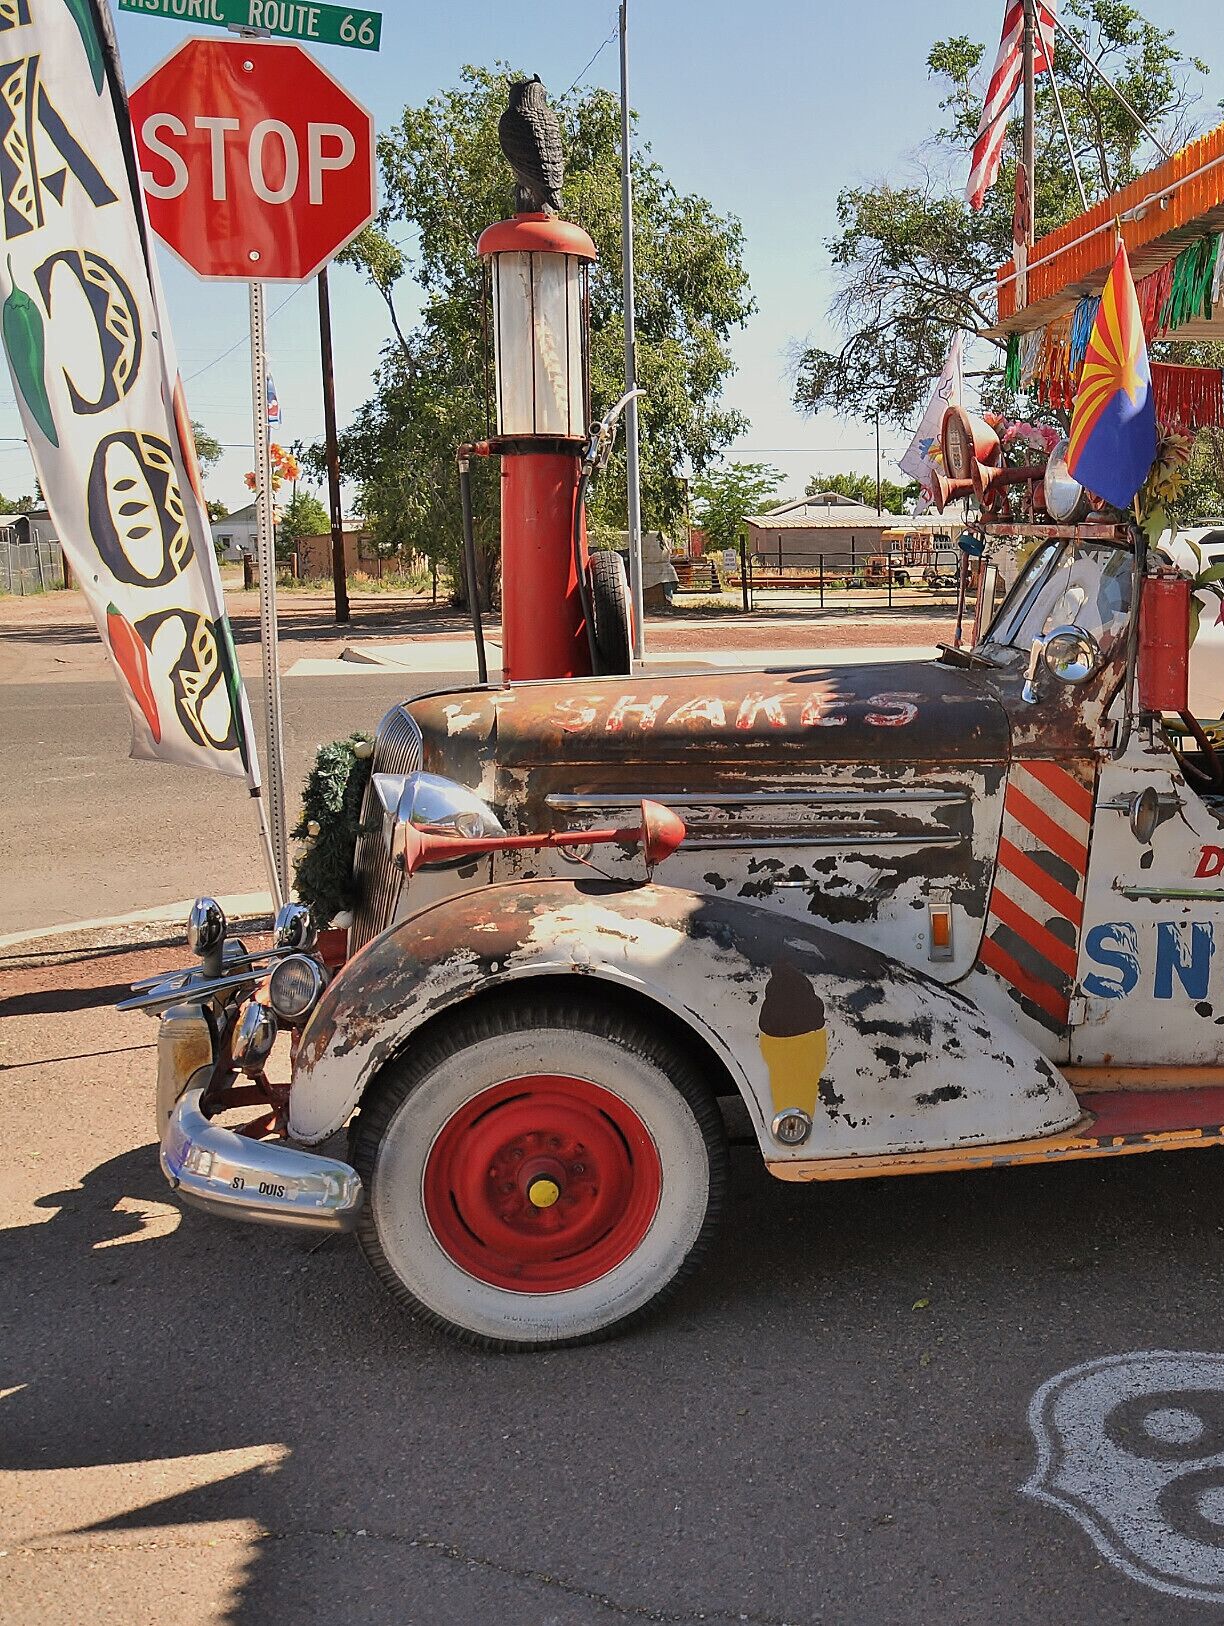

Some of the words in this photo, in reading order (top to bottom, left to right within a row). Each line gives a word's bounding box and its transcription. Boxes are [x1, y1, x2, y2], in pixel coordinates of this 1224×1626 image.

[248, 0, 321, 37] ROUTE
[340, 14, 375, 45] 66
[139, 112, 356, 205] STOP
[548, 690, 922, 734] SHAKES
